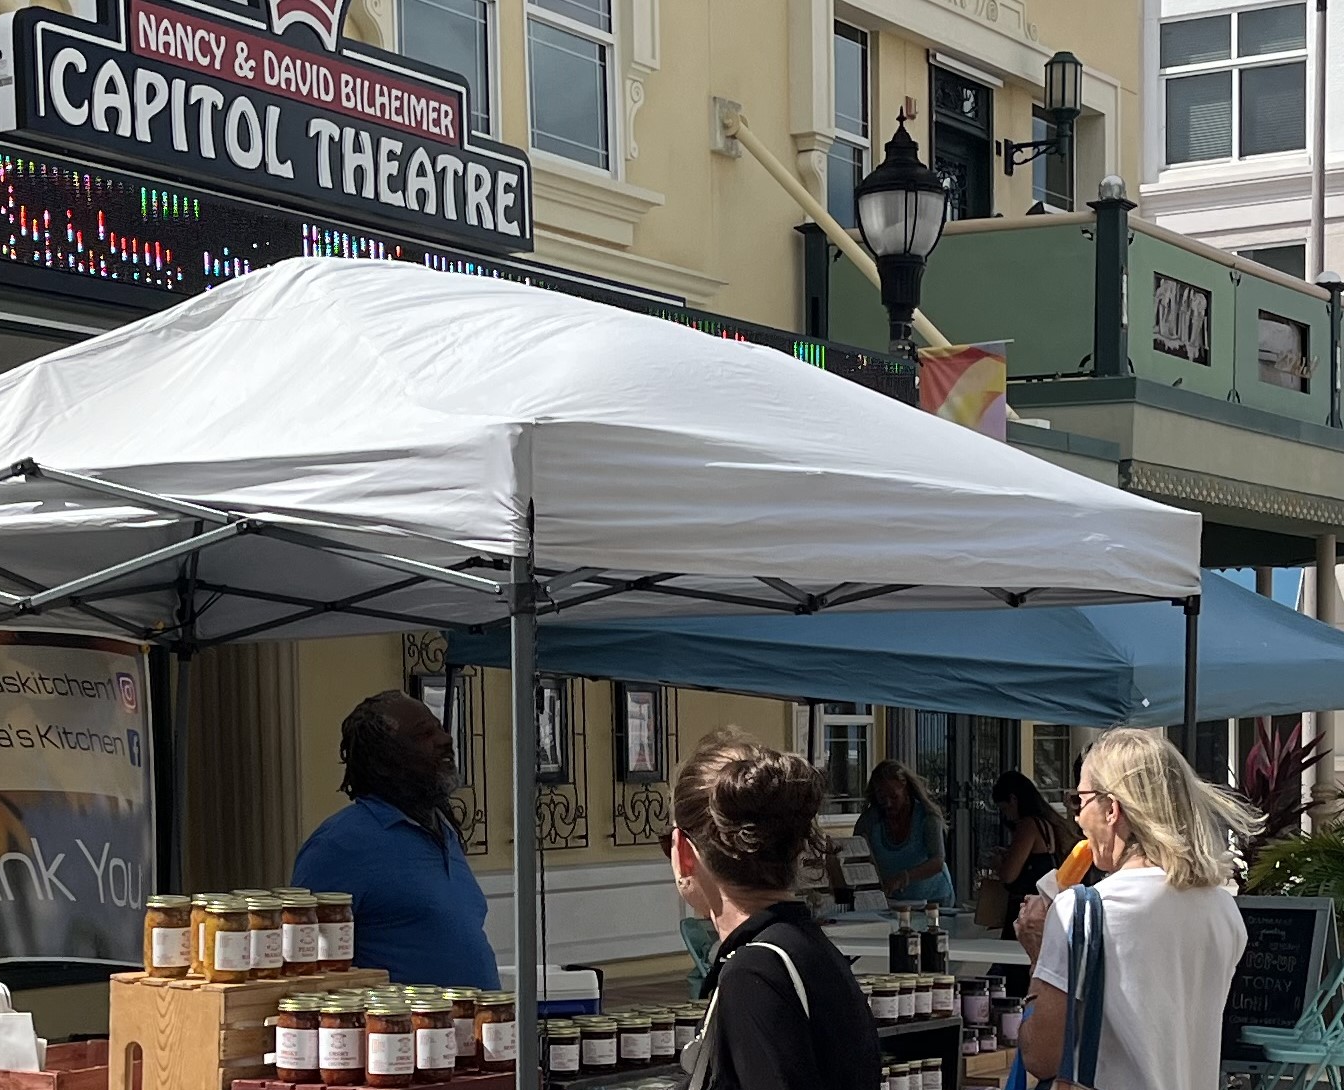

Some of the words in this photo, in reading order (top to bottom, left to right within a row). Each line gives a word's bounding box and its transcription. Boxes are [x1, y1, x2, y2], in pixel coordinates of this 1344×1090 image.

[138, 14, 224, 70] NANCY
[234, 42, 257, 78] &
[263, 50, 336, 103] DAVID
[340, 73, 455, 138] BILHEIMER
[50, 47, 294, 178] CAPITOL
[309, 118, 521, 237] THEATRE
[40, 725, 125, 756] Kitchen
[75, 839, 144, 912] You
[1242, 976, 1293, 992] TODAY
